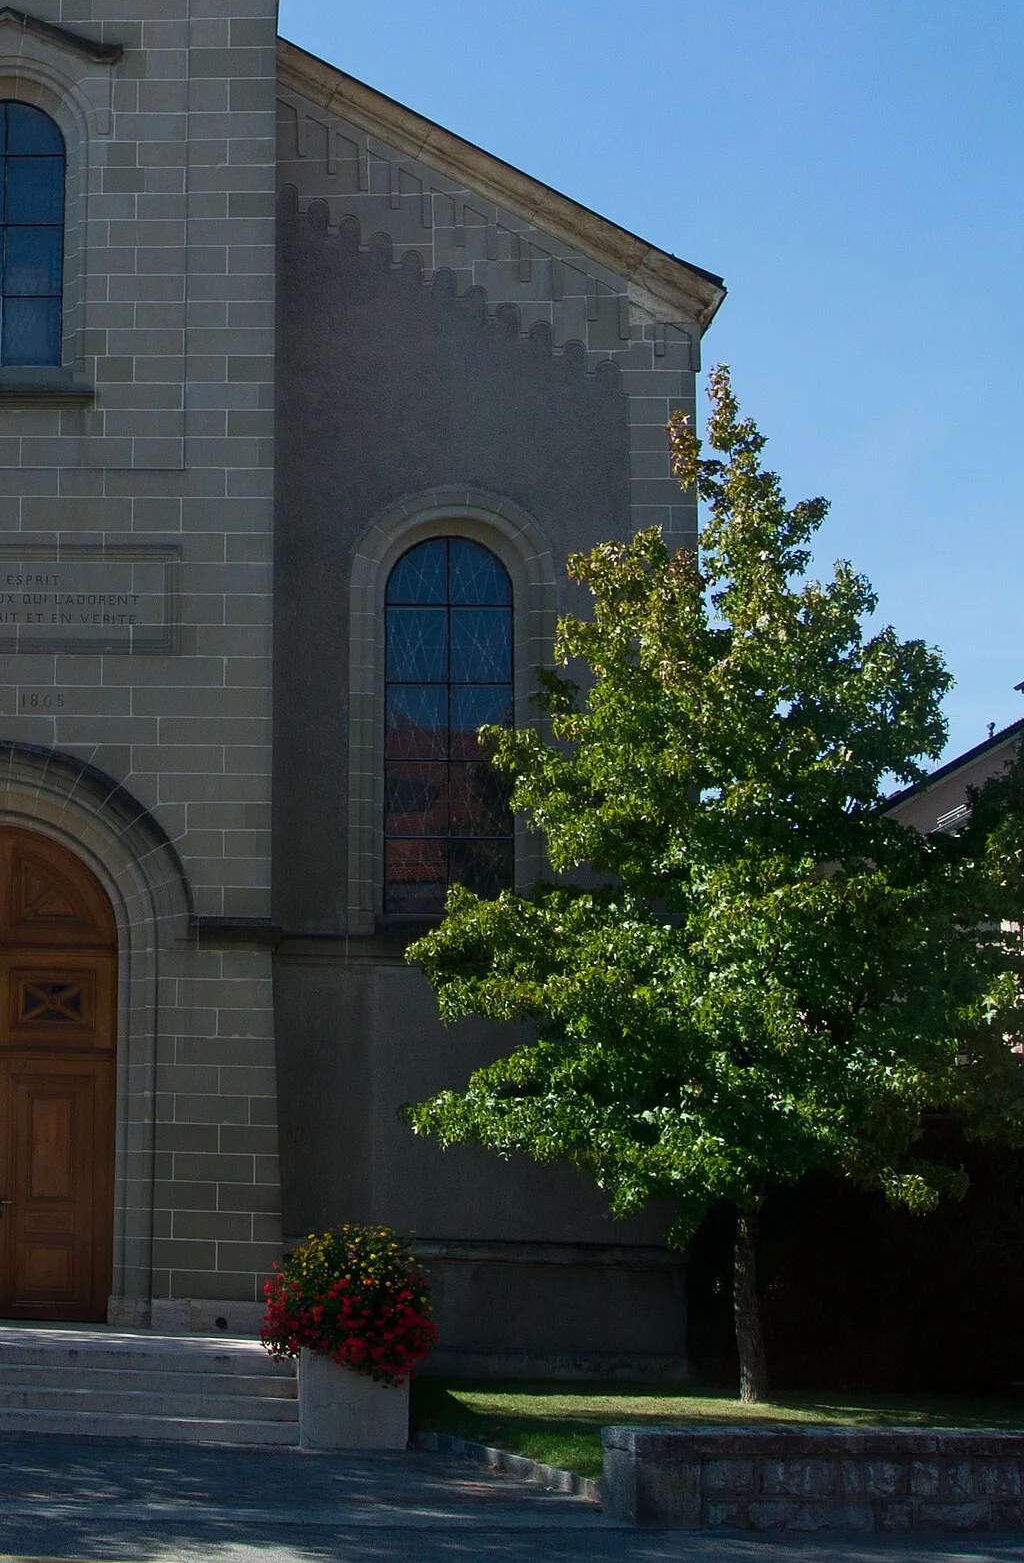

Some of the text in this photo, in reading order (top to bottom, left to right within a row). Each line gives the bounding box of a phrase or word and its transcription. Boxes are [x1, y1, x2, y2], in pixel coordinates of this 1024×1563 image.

[22, 593, 47, 604] QUI
[54, 594, 141, 606] L'ADORENT
[26, 613, 44, 624] ET
[51, 613, 72, 624] EN
[22, 692, 65, 708] 1865
